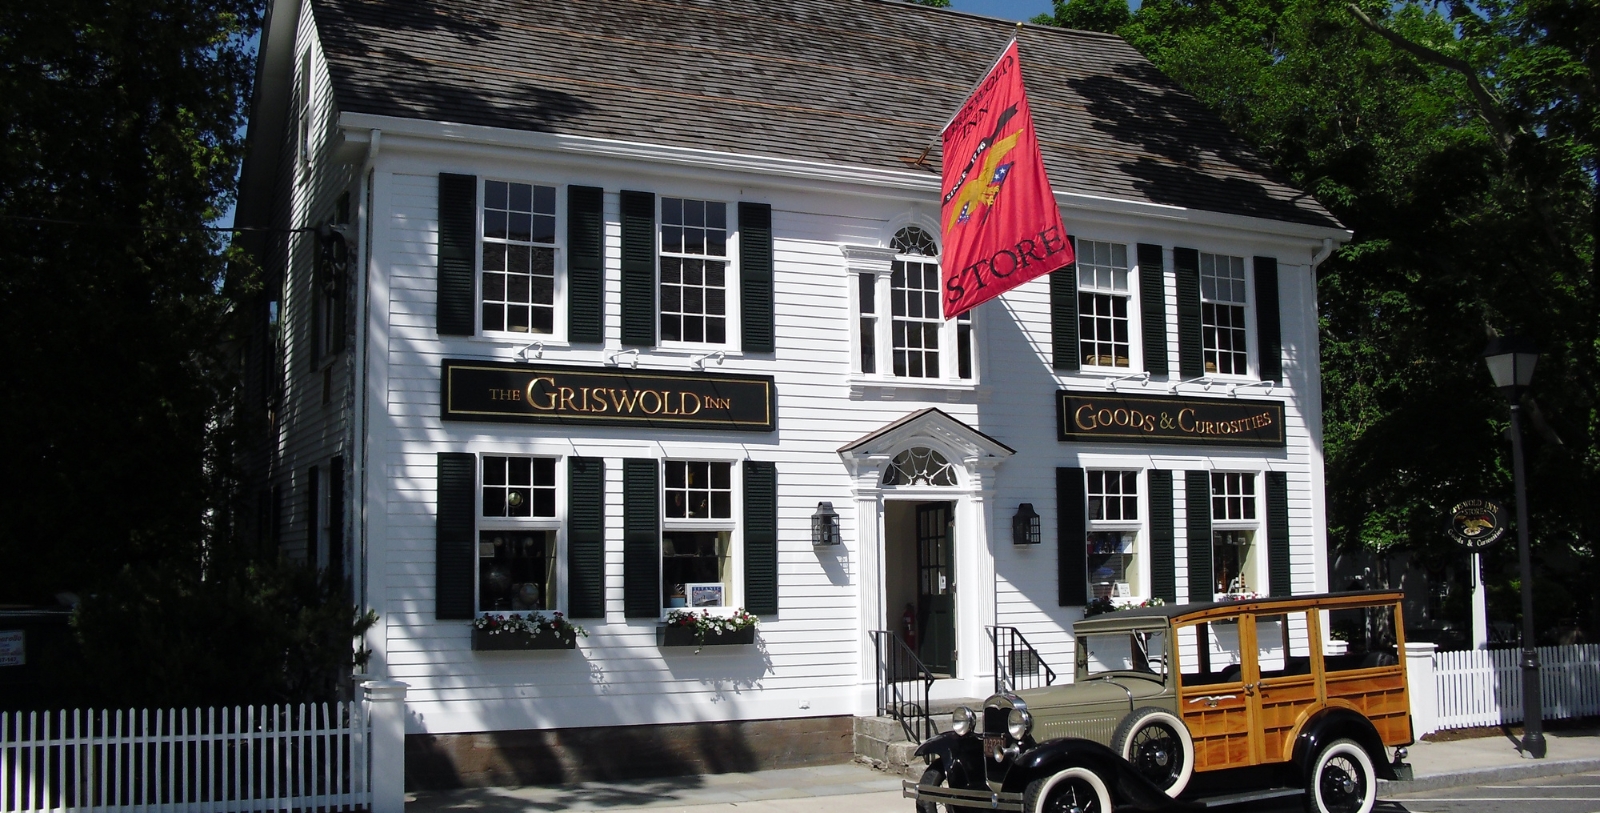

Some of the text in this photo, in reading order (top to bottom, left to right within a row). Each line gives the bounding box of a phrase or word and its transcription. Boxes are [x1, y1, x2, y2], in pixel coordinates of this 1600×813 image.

[962, 100, 990, 140] INN
[946, 141, 986, 201] SINCE 1776
[946, 225, 1066, 304] STORE
[489, 376, 731, 416] THE GRISWOLD INN
[1074, 403, 1273, 436] GOODS & CURIOSITIES
[1467, 539, 1473, 547] &
[1476, 527, 1504, 546] Curiosities
